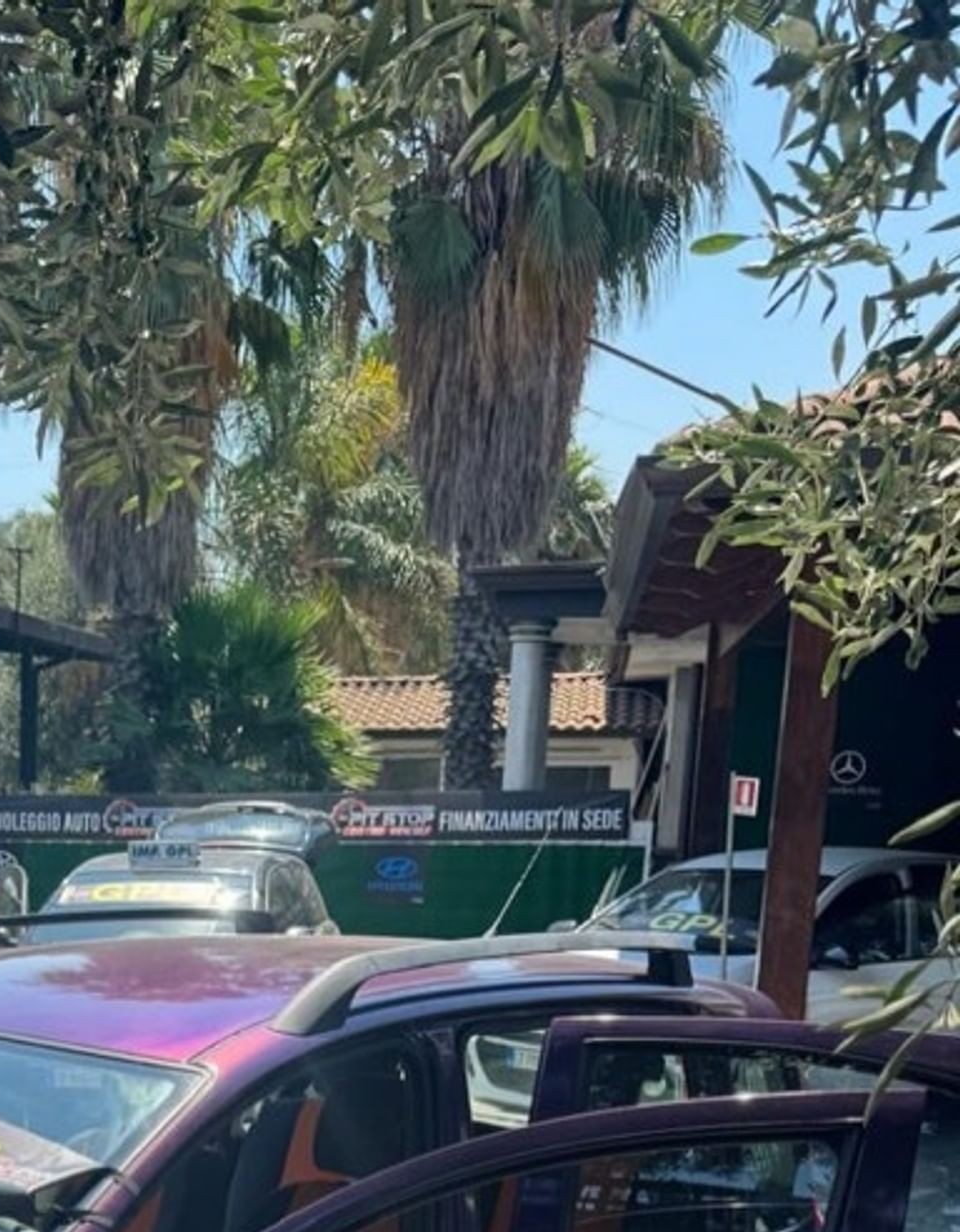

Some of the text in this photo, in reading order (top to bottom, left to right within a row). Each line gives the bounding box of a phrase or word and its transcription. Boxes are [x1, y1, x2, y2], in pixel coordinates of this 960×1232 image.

[62, 811, 101, 832] AUTO
[439, 809, 558, 832] FINANZIAMENTI
[561, 810, 579, 831] IN
[582, 810, 623, 831] SEDE
